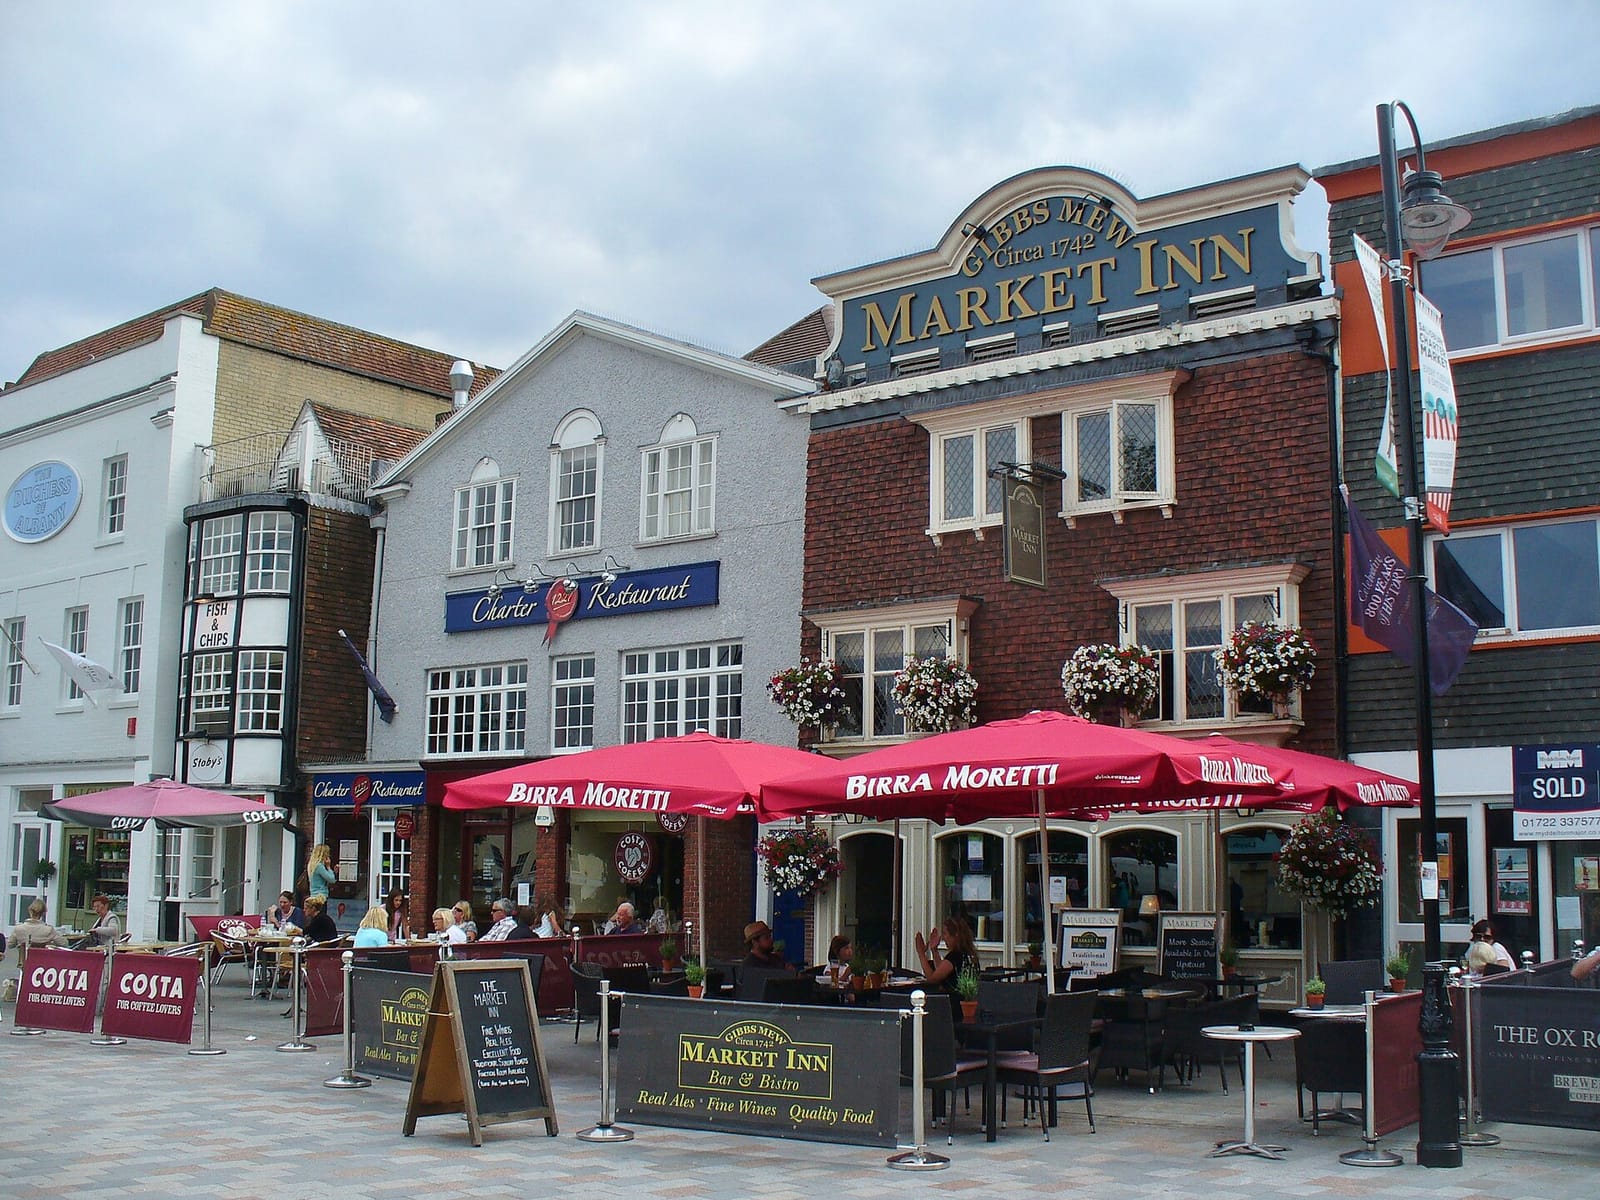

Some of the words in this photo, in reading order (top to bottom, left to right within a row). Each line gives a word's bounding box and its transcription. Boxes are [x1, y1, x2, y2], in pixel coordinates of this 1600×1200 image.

[960, 198, 1050, 278] GIBBS
[1056, 198, 1138, 249] MEW
[993, 243, 1044, 269] Circa
[1049, 233, 1095, 258] 1742
[860, 256, 1117, 353] MARKET
[1132, 227, 1256, 296] INN
[1420, 345, 1448, 369] MARKET
[13, 475, 72, 508] DUCHESS
[14, 501, 66, 535] ALBANY
[472, 593, 538, 622] Charter
[587, 575, 691, 610] Restaurant
[1364, 594, 1382, 618] 800
[206, 602, 228, 617] FISH
[211, 618, 219, 631] &
[199, 632, 228, 647] CHIPS
[1537, 749, 1583, 769] MM
[1199, 755, 1233, 783] BIRRA
[1231, 756, 1275, 785] MORETTI
[314, 781, 350, 798] Charter
[371, 780, 424, 797] Restaurant
[846, 773, 933, 800] BIRRA
[942, 763, 1060, 790] MORETTI
[1356, 782, 1381, 804] BIRRA
[1379, 780, 1410, 801] MORETTI
[1532, 777, 1585, 799] SOLD
[504, 782, 576, 805] BIRRA
[581, 782, 671, 810] MORETTI
[242, 810, 285, 824] COSTA
[661, 814, 687, 830] COFFEE
[1521, 818, 1557, 827] 01722
[1559, 817, 1600, 827] 337577
[620, 835, 645, 848] COSTA
[618, 861, 648, 878] COFFEE
[1166, 920, 1199, 928] MARKET
[1202, 920, 1215, 928] IN
[31, 967, 89, 992] COSTA
[120, 972, 183, 999] COSTA
[480, 980, 498, 992] THE
[28, 992, 40, 1002] FOR
[40, 993, 62, 1005] COFFEE
[62, 996, 86, 1007] LOVERS
[116, 999, 130, 1010] FOR
[130, 1001, 156, 1013] COFFEE
[156, 1003, 181, 1016] LOVERS
[473, 991, 508, 1007] MARKET
[382, 1005, 426, 1027] MARKET
[395, 1028, 409, 1042] Bar
[410, 1030, 418, 1043] &
[725, 1024, 758, 1042] GIBBS
[759, 1026, 788, 1045] MEW
[735, 1037, 754, 1046] Circa
[755, 1040, 774, 1048] 1742
[1494, 1025, 1539, 1044] THE
[1544, 1028, 1577, 1047] OX
[1582, 1030, 1600, 1048] R
[364, 1045, 379, 1058] Real
[396, 1051, 410, 1064] Fine
[681, 1040, 778, 1069] MARKET
[785, 1048, 829, 1073] INN
[708, 1070, 734, 1087] Bar
[738, 1071, 754, 1087] &
[759, 1074, 800, 1091] Bistro
[1556, 1077, 1600, 1089] BREWE
[638, 1090, 667, 1106] Real
[670, 1092, 696, 1109] Ales
[707, 1097, 735, 1113] Fine
[739, 1099, 778, 1117] Wines
[789, 1104, 838, 1126] Quality
[842, 1108, 874, 1125] Food
